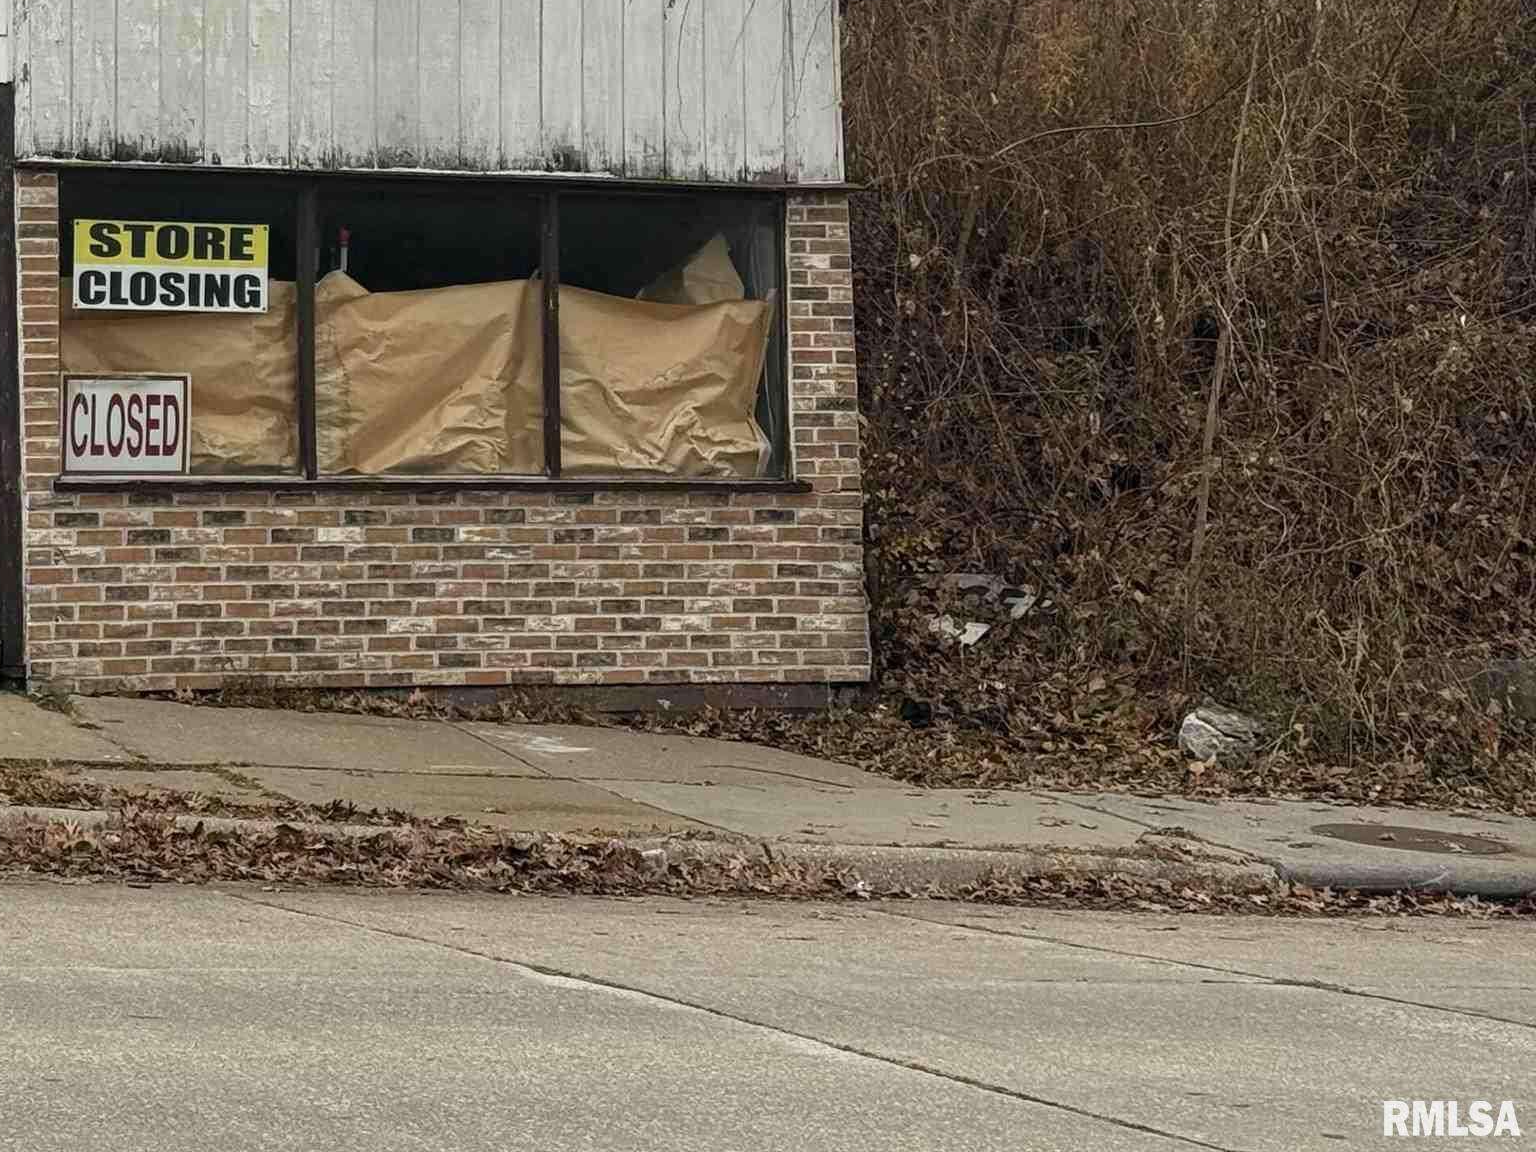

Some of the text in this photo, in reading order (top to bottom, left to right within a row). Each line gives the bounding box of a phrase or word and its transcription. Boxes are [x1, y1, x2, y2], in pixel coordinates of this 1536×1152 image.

[89, 222, 255, 261] STORE
[77, 270, 262, 309] CLOSING
[70, 393, 181, 458] CLOSED
